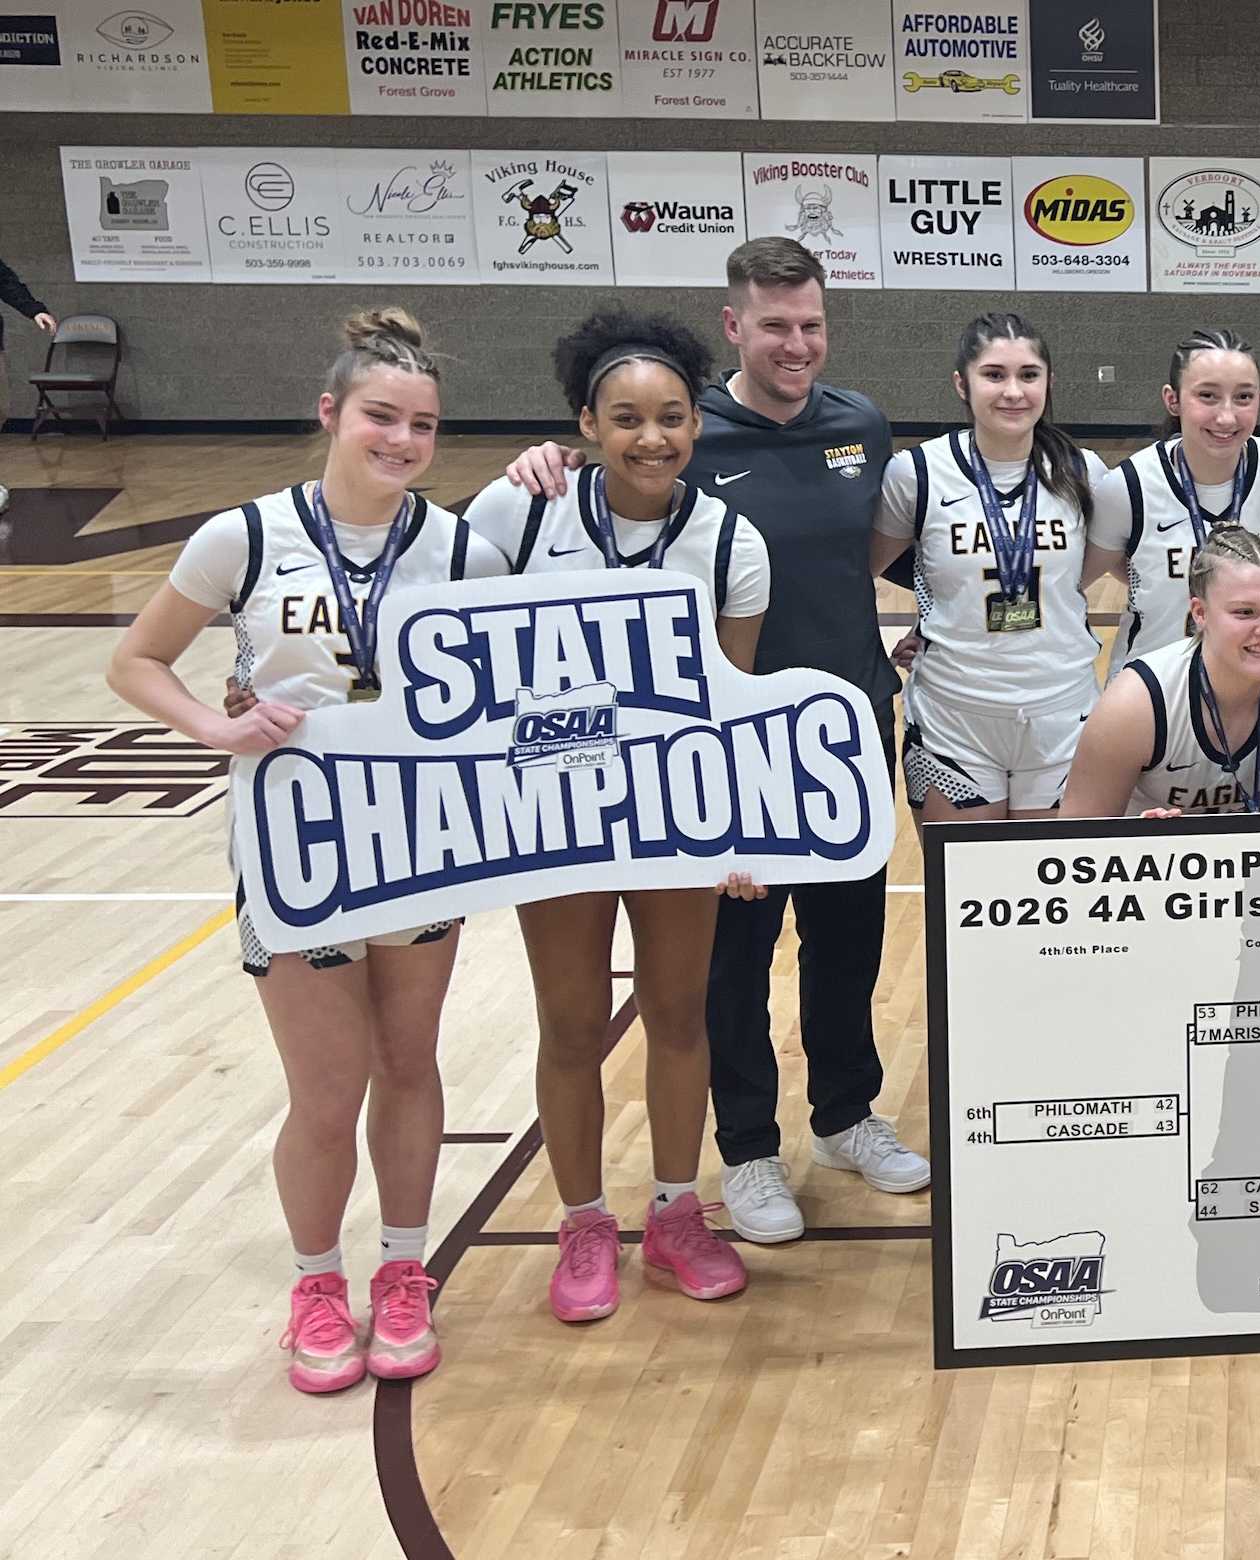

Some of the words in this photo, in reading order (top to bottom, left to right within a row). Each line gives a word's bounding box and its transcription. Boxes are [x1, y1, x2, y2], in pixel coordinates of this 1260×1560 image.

[353, 4, 393, 27] VAN
[398, 0, 471, 27] DOREN
[491, 3, 605, 30] FRYES
[903, 14, 1018, 35] AFFORDABLE
[356, 31, 470, 52] Red-E-Mix
[763, 36, 853, 51] ACCURATE
[905, 39, 1017, 59] AUTOMOTIVE
[77, 53, 200, 64] RICHARDSON
[508, 48, 593, 66] ACTION
[624, 50, 684, 61] MIRACLE
[690, 50, 723, 61] SIGN
[729, 51, 751, 62] CO.
[789, 53, 886, 68] BACKFLOW
[361, 56, 470, 77] CONCRETE
[663, 68, 682, 78] EST
[688, 68, 716, 79] 1977
[492, 72, 613, 91] ATHLETICS
[1048, 80, 1081, 93] Tuality
[1084, 81, 1138, 92] Healthcare
[379, 85, 414, 98] Forest
[419, 86, 455, 98] Grove
[484, 161, 538, 184] Viking
[546, 160, 595, 185] House
[753, 164, 788, 184] Viking
[791, 161, 843, 179] Booster
[845, 166, 869, 187] Club
[889, 179, 1002, 205] LITTLE
[657, 201, 733, 220] Wauna
[1033, 188, 1127, 223] MIDAS
[218, 216, 330, 237] C.ELLIS
[657, 222, 693, 233] Credit
[696, 223, 735, 233] Union
[911, 210, 981, 236] GUY
[229, 240, 324, 249] CONSTRUCTION
[358, 256, 465, 268] 503.703.0069
[493, 260, 599, 272] fghsvikinghouse.com
[893, 250, 1002, 268] WRESTLING
[1032, 255, 1130, 267] 503-648-3304
[404, 590, 708, 735] STATE
[514, 706, 616, 744] OSAA
[514, 746, 541, 755] STATE
[541, 739, 615, 752] CHAMPIONSHIPS
[562, 751, 606, 765] OnPoint
[256, 694, 868, 922] CHAMPIONS
[960, 897, 1069, 928] 2026
[1089, 895, 1145, 922] 4A
[1039, 945, 1087, 957] 4th/6th
[1091, 943, 1129, 955] Place
